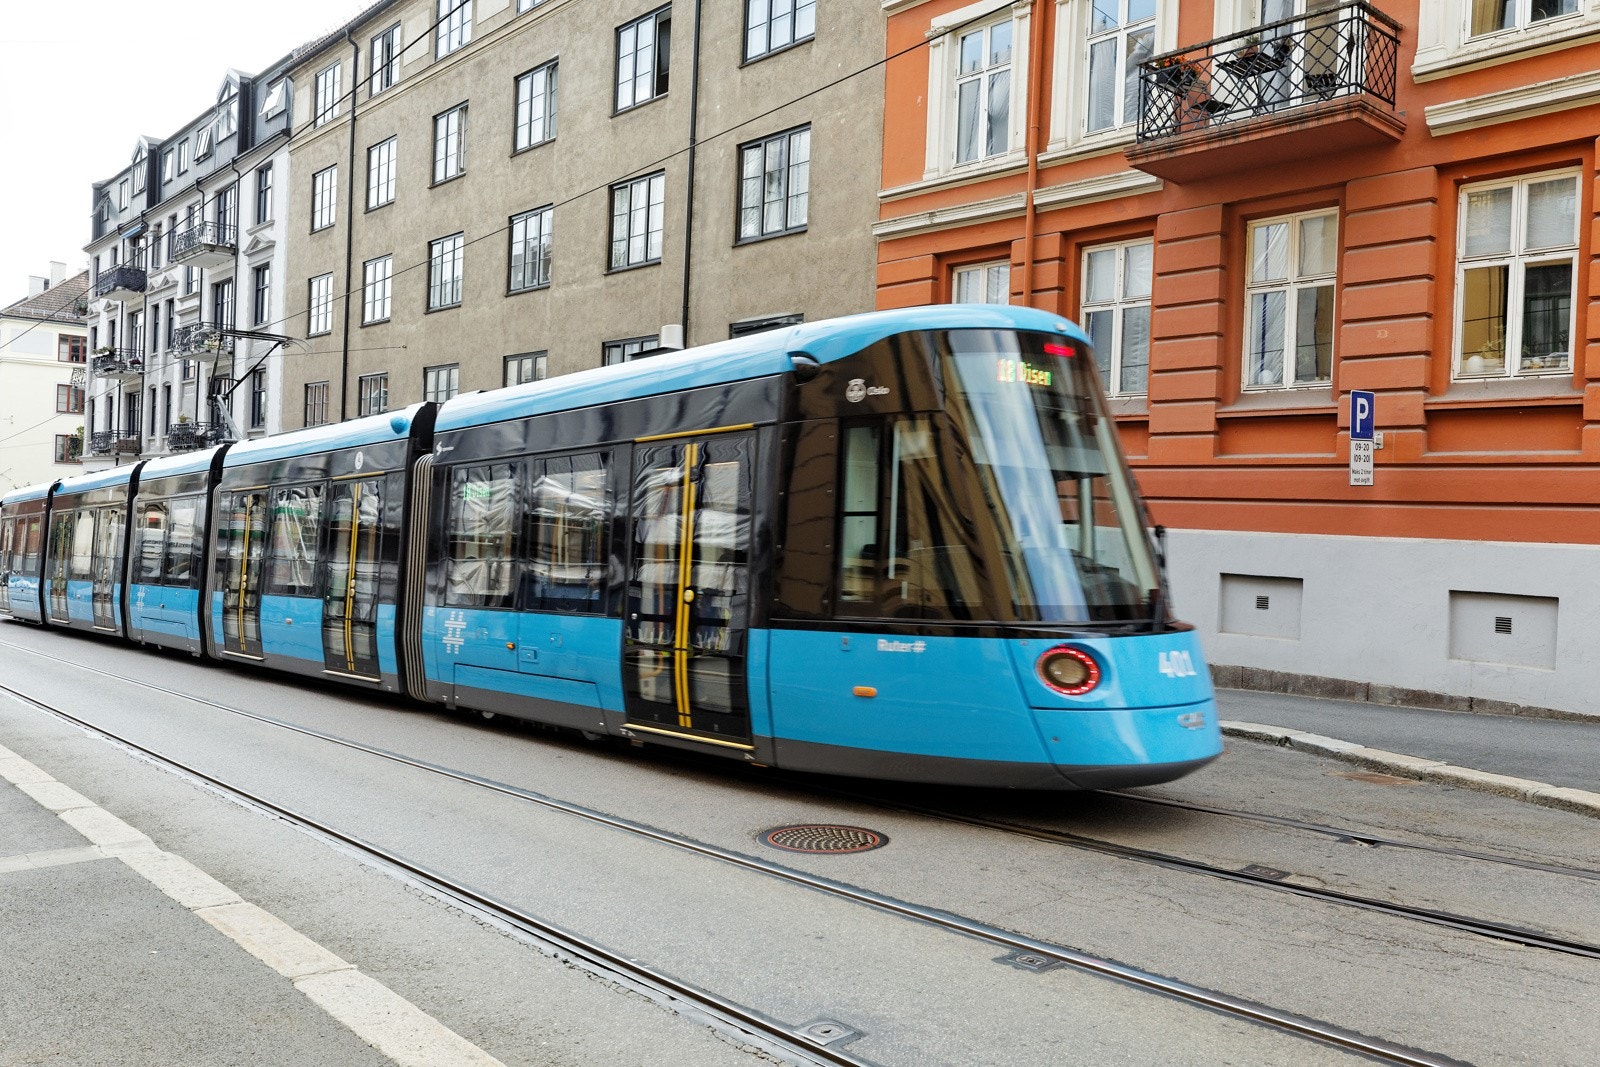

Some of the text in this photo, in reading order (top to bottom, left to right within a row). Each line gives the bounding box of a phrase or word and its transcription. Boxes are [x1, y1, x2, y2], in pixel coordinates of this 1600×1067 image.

[1357, 398, 1369, 432] P
[1355, 443, 1369, 451] 09-20
[1159, 650, 1197, 678] 401
